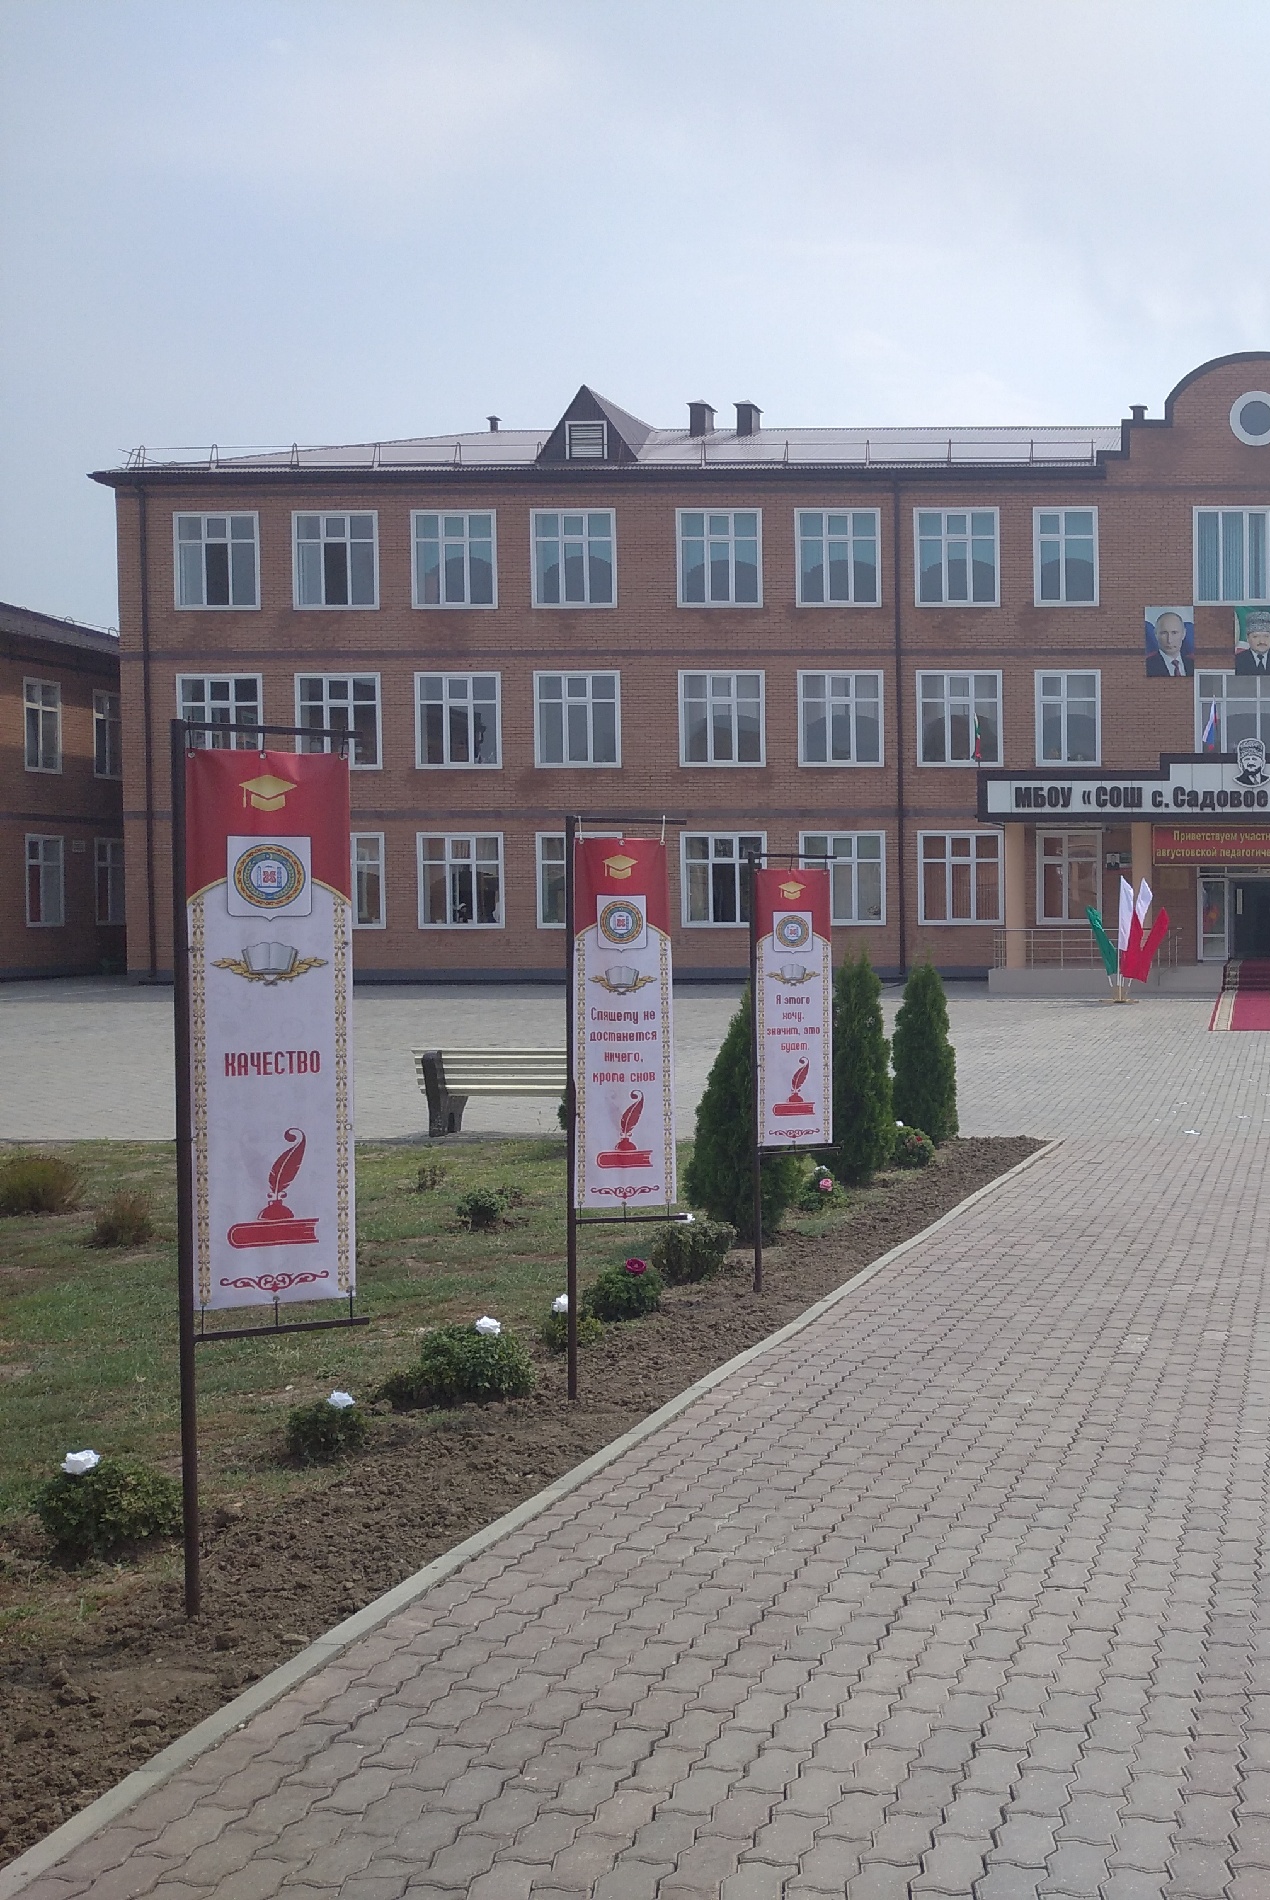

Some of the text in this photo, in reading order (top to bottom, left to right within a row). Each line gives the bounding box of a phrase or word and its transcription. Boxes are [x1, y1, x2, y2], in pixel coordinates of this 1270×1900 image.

[1014, 786, 1073, 808] МБОУ
[1173, 830, 1237, 843] Приветствуем
[1156, 847, 1217, 859] августовской
[776, 994, 811, 1005] Я этого
[591, 1007, 656, 1024] Спящему не
[590, 1031, 657, 1042] достанется
[803, 1026, 821, 1035] это
[224, 1050, 321, 1077] КАЧЕСТВО
[592, 1072, 656, 1085] кроме снов
